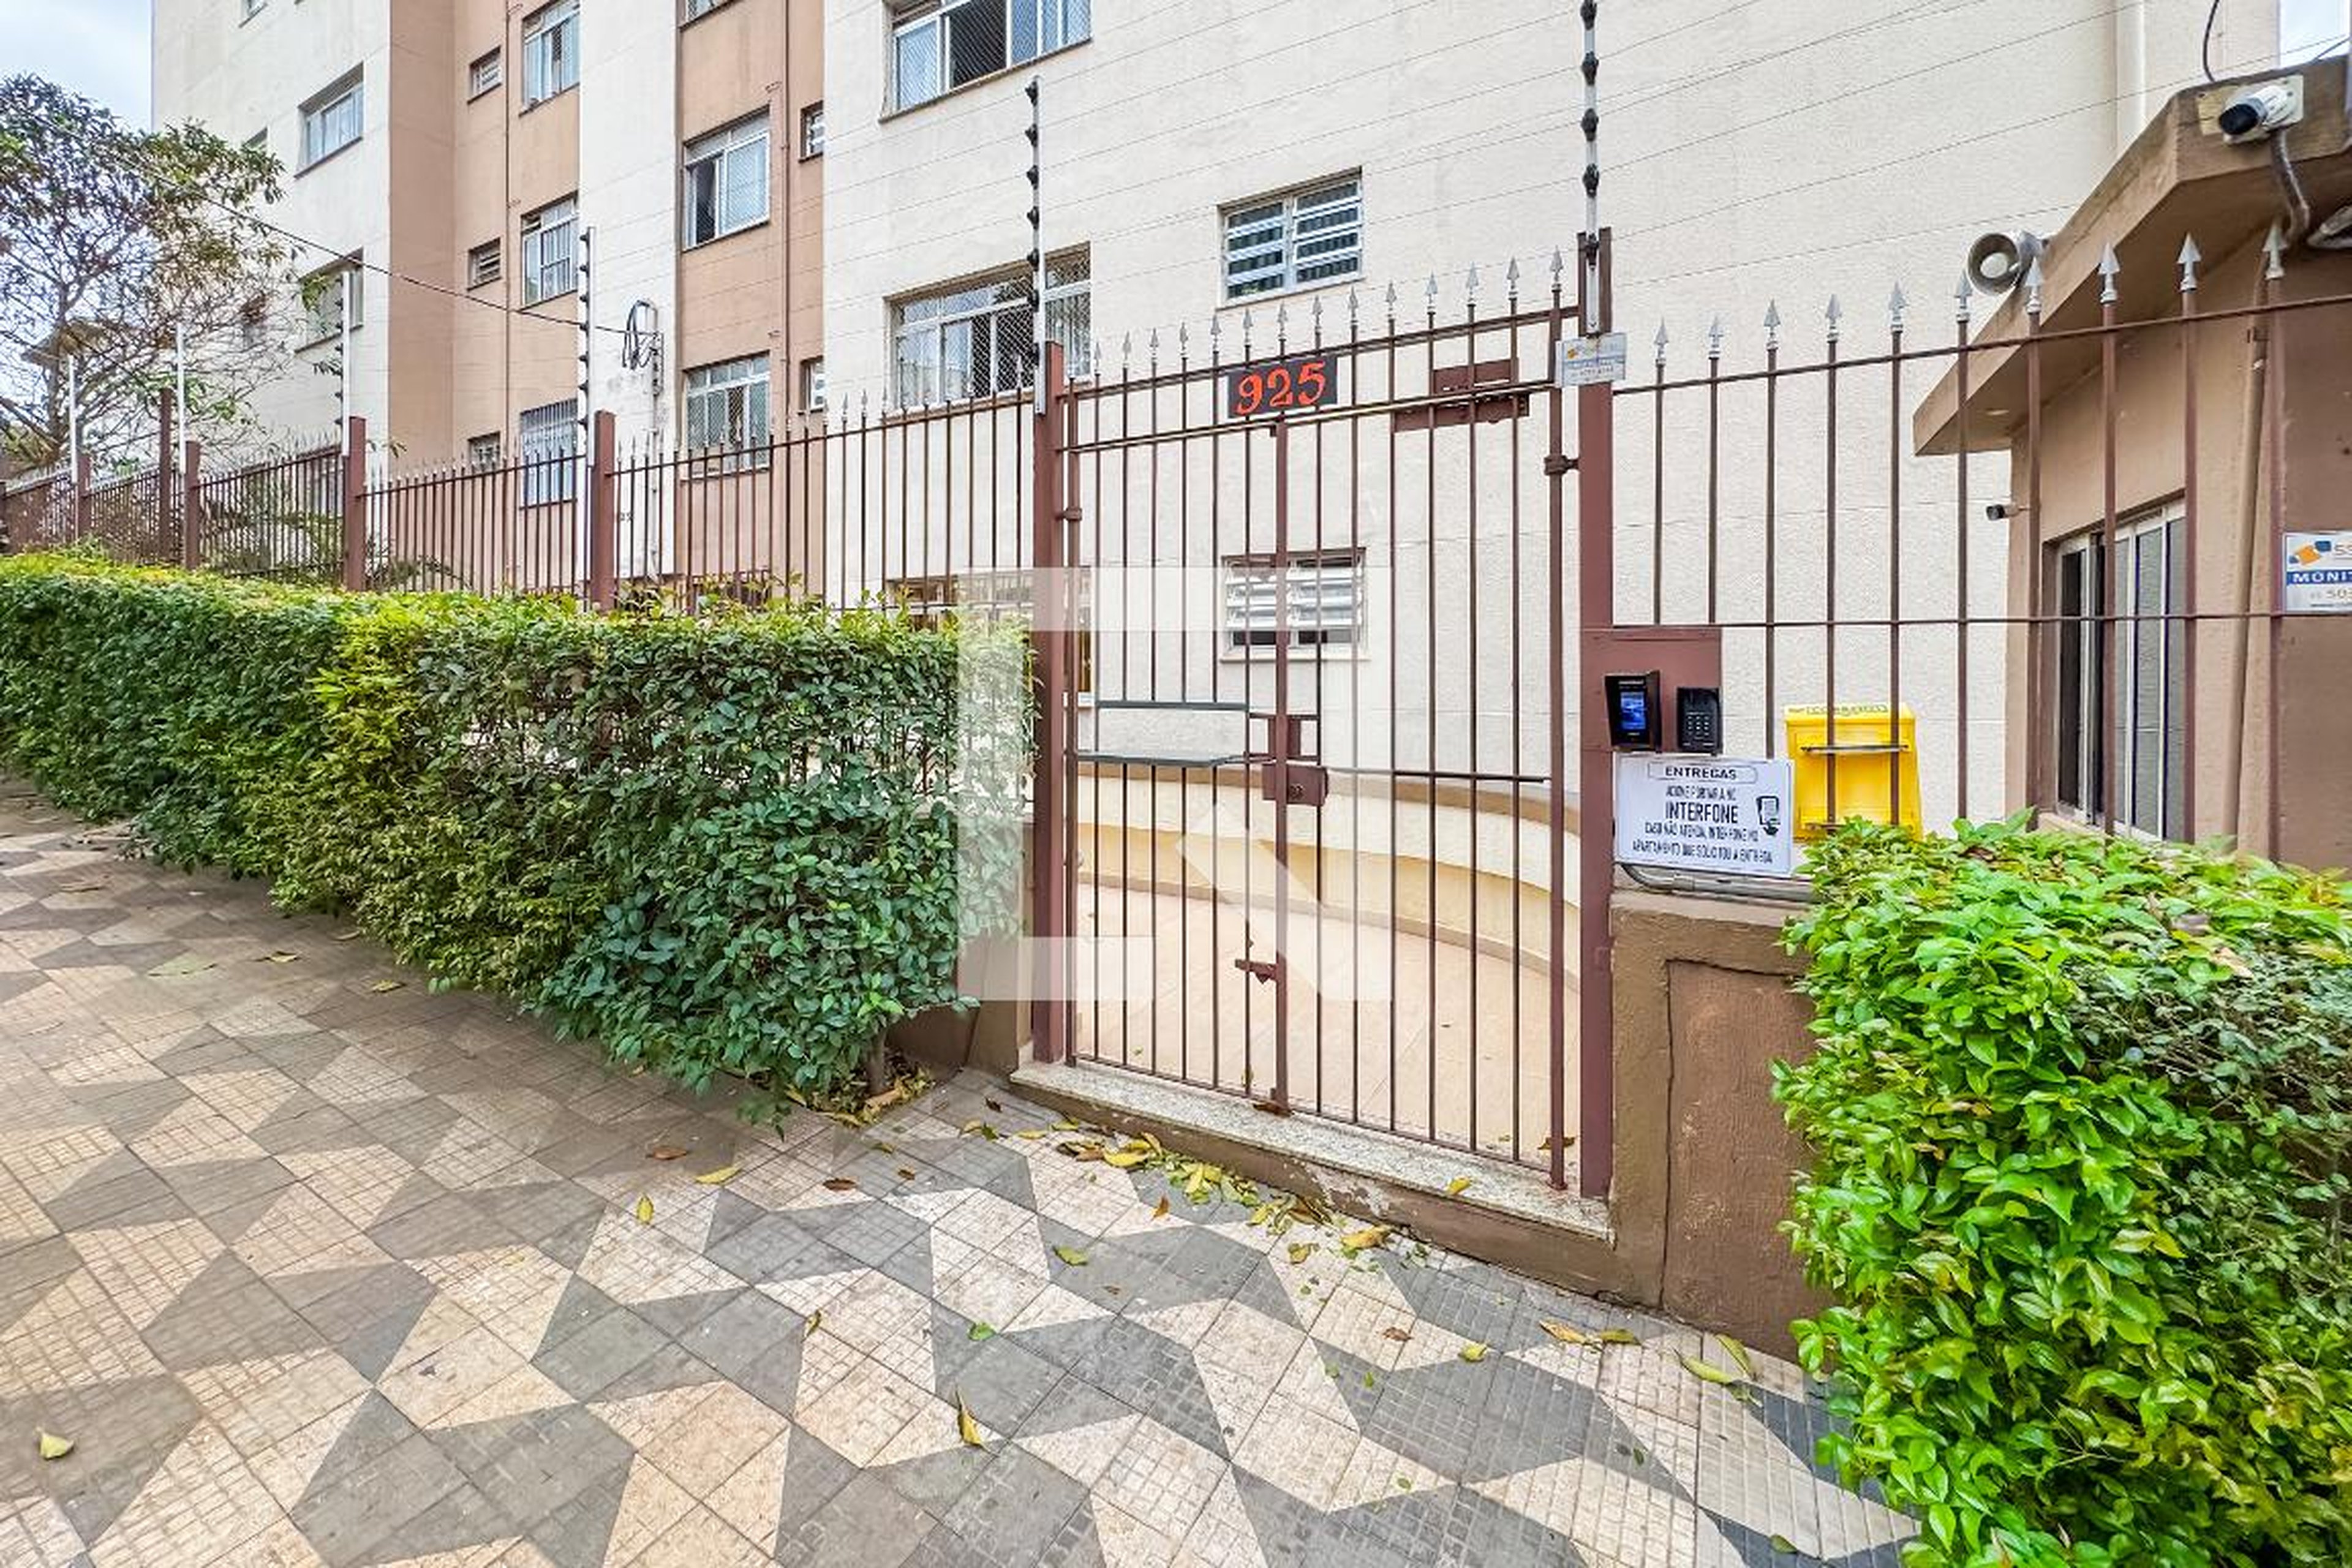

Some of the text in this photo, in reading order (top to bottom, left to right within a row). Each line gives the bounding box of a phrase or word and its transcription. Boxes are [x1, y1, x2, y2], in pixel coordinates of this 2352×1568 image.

[1236, 360, 1326, 415] 925
[1665, 767, 1736, 780] ENTREGAS
[1665, 801, 1738, 823] INTERFONE
